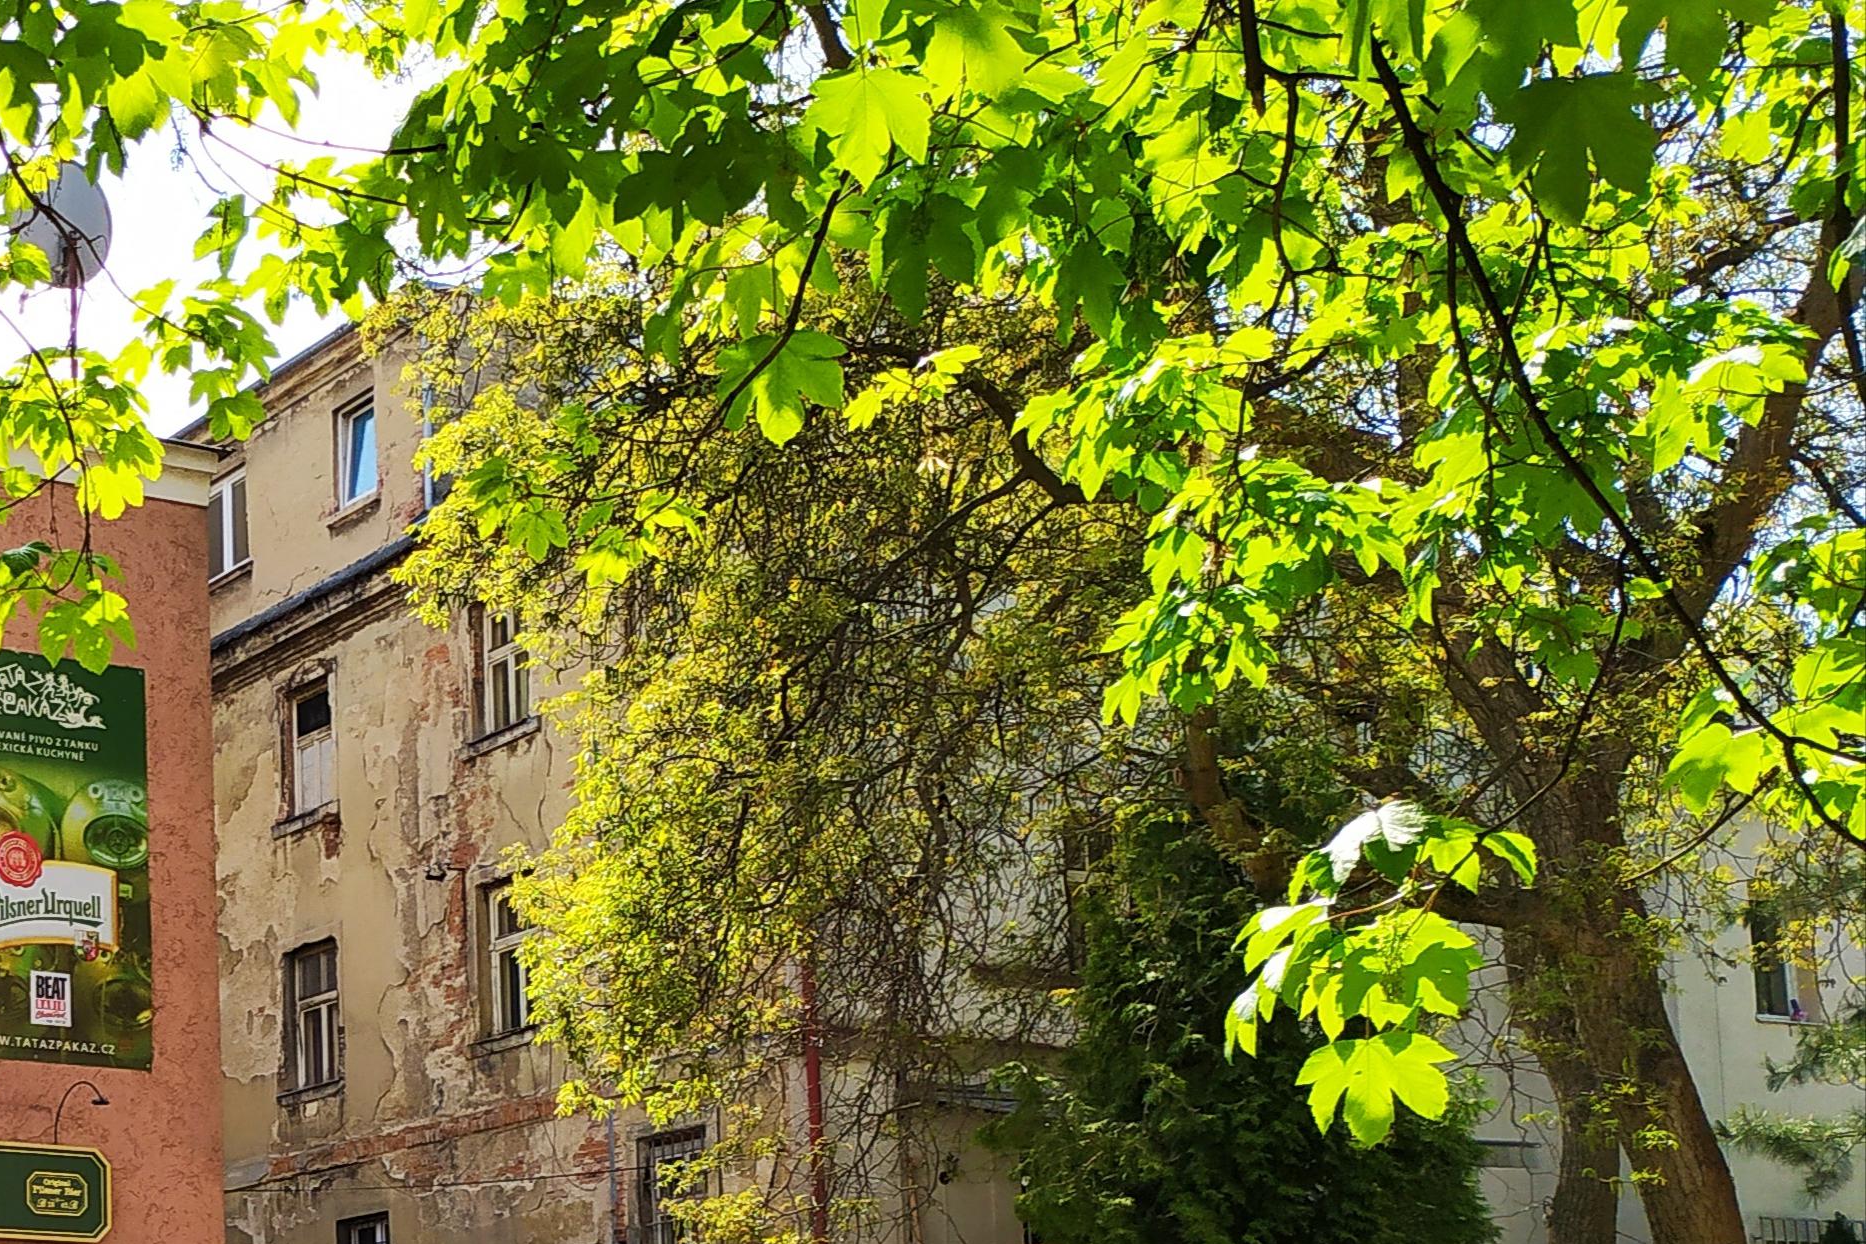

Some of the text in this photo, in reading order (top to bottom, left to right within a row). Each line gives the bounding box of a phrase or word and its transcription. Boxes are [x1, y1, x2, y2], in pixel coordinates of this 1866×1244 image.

[29, 734, 53, 746] PIVO
[55, 738, 61, 747] Z
[64, 738, 99, 751] TANKU
[36, 747, 85, 761] KUCHYNĚ
[41, 888, 101, 926] Urquell
[36, 975, 67, 1000] BEAT
